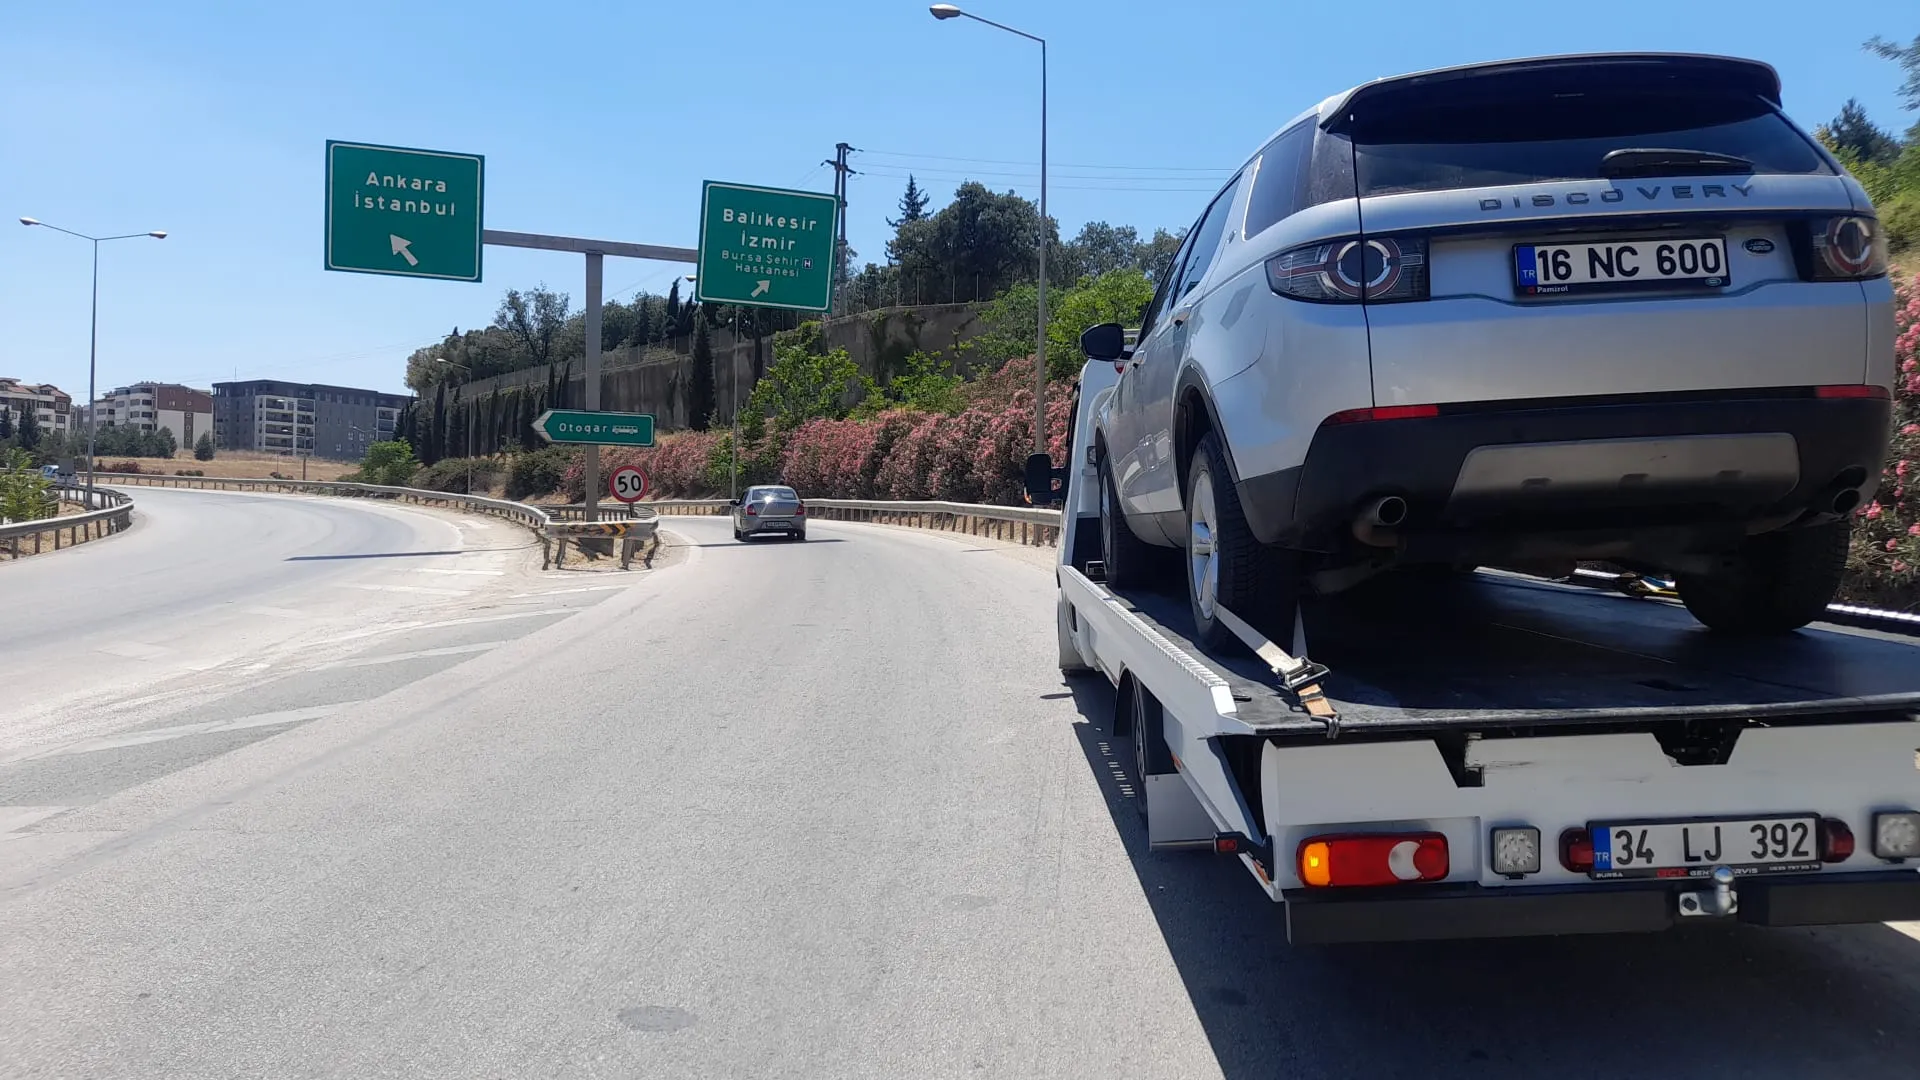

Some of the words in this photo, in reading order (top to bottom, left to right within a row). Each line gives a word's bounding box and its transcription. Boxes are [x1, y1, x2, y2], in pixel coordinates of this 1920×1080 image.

[366, 171, 446, 193] Ankara
[354, 190, 455, 216] İstanbul
[1478, 184, 1754, 211] DISCOVERY
[723, 208, 817, 231] Balıkesir
[741, 230, 795, 251] İzmir
[722, 250, 762, 263] Bursa
[1522, 269, 1536, 279] TR
[1537, 249, 1572, 281] 16
[1587, 245, 1640, 279] NC
[1655, 242, 1721, 276] 600
[735, 262, 800, 278] Hastanesi
[559, 423, 607, 435] Otogar
[617, 474, 642, 493] 50
[1595, 851, 1610, 862] TR
[1614, 829, 1655, 866] 34
[1682, 825, 1723, 863] LJ
[1749, 822, 1810, 860] 392
